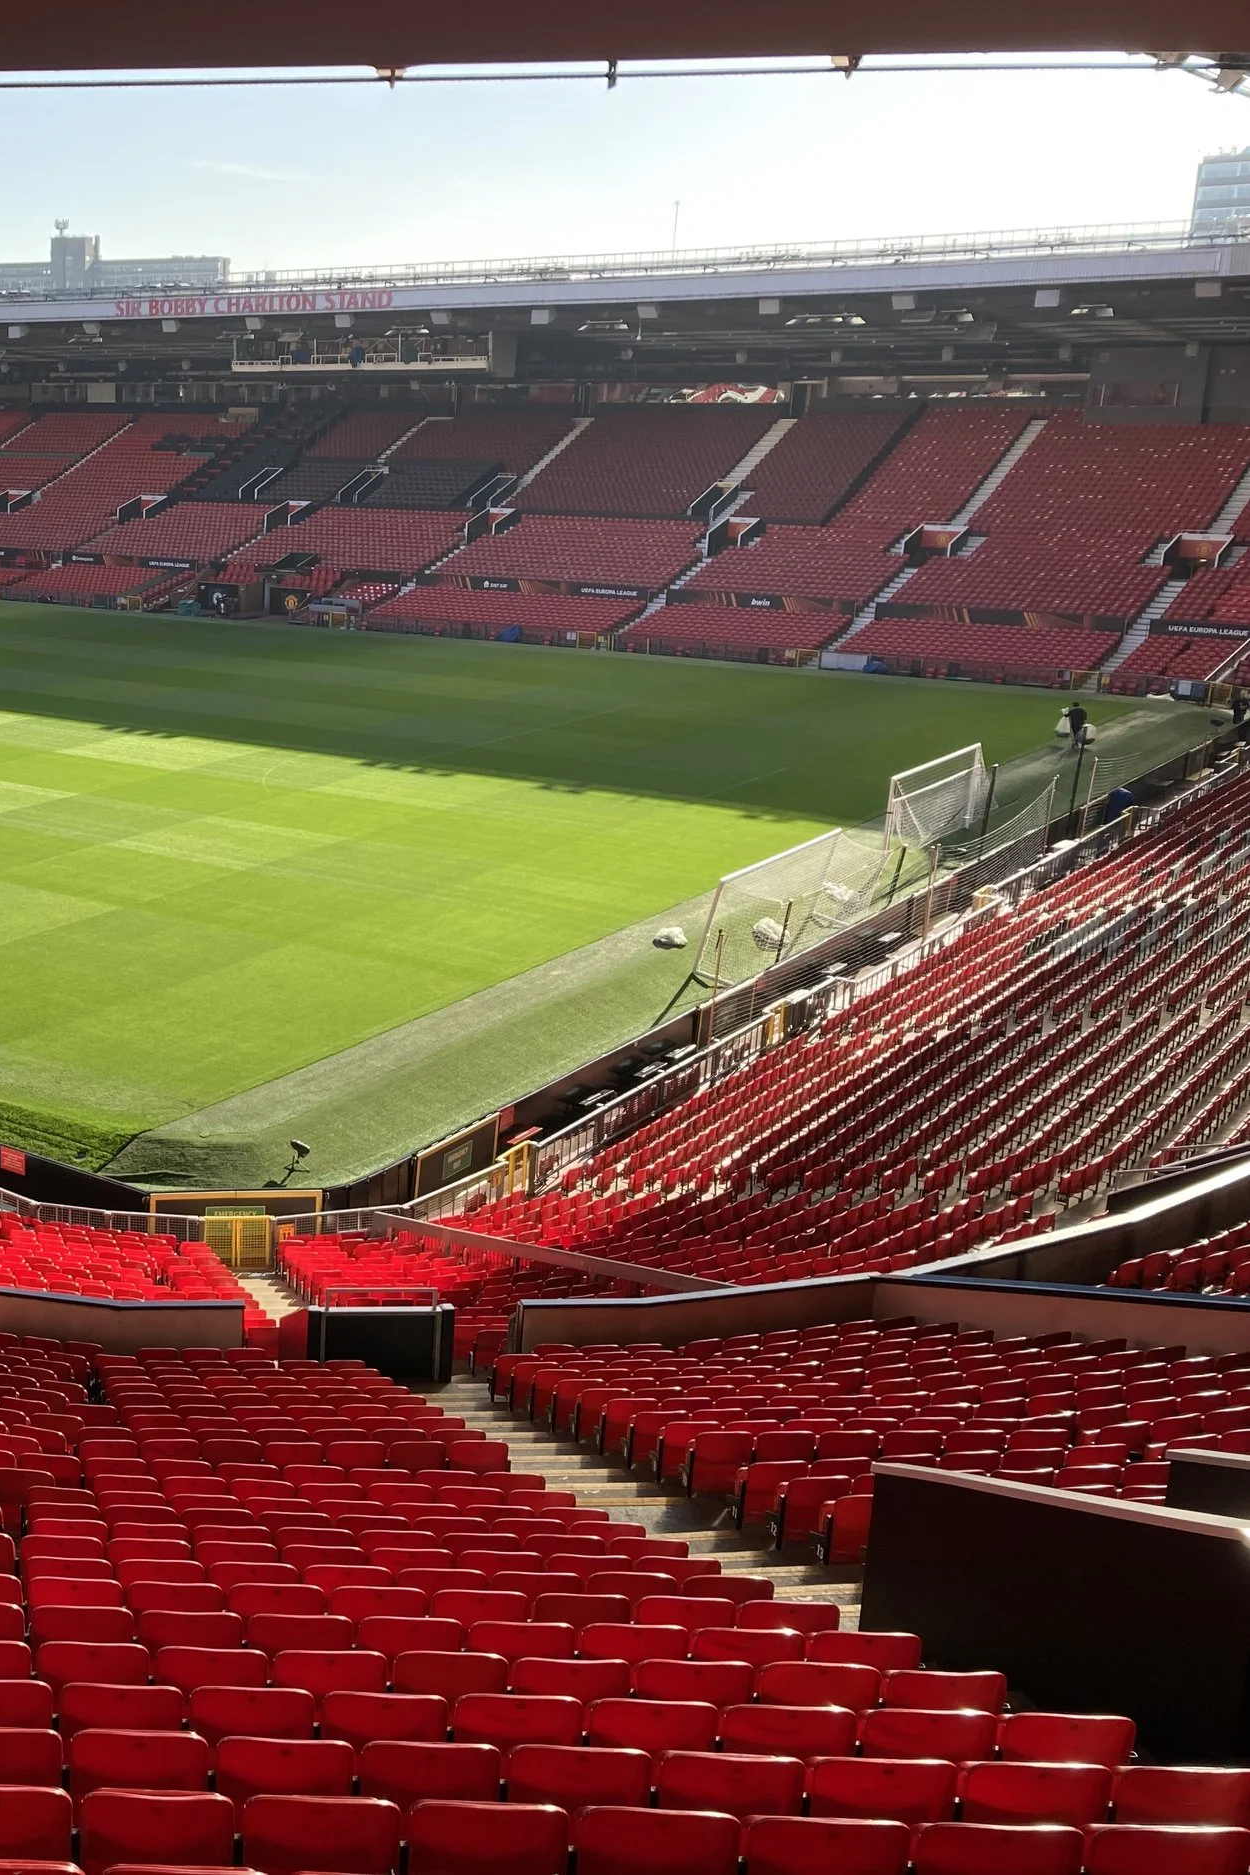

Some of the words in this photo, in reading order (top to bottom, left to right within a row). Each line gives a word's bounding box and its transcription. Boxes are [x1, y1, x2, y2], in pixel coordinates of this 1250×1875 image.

[115, 299, 141, 317] SIR
[150, 297, 207, 317] BOBBY
[214, 292, 316, 314] CHARLTON
[325, 290, 392, 311] STAND
[617, 589, 638, 597] LEAGUE
[751, 597, 770, 607] bwin
[1189, 626, 1217, 634] EUROPA
[1219, 628, 1248, 637] LEAGUE
